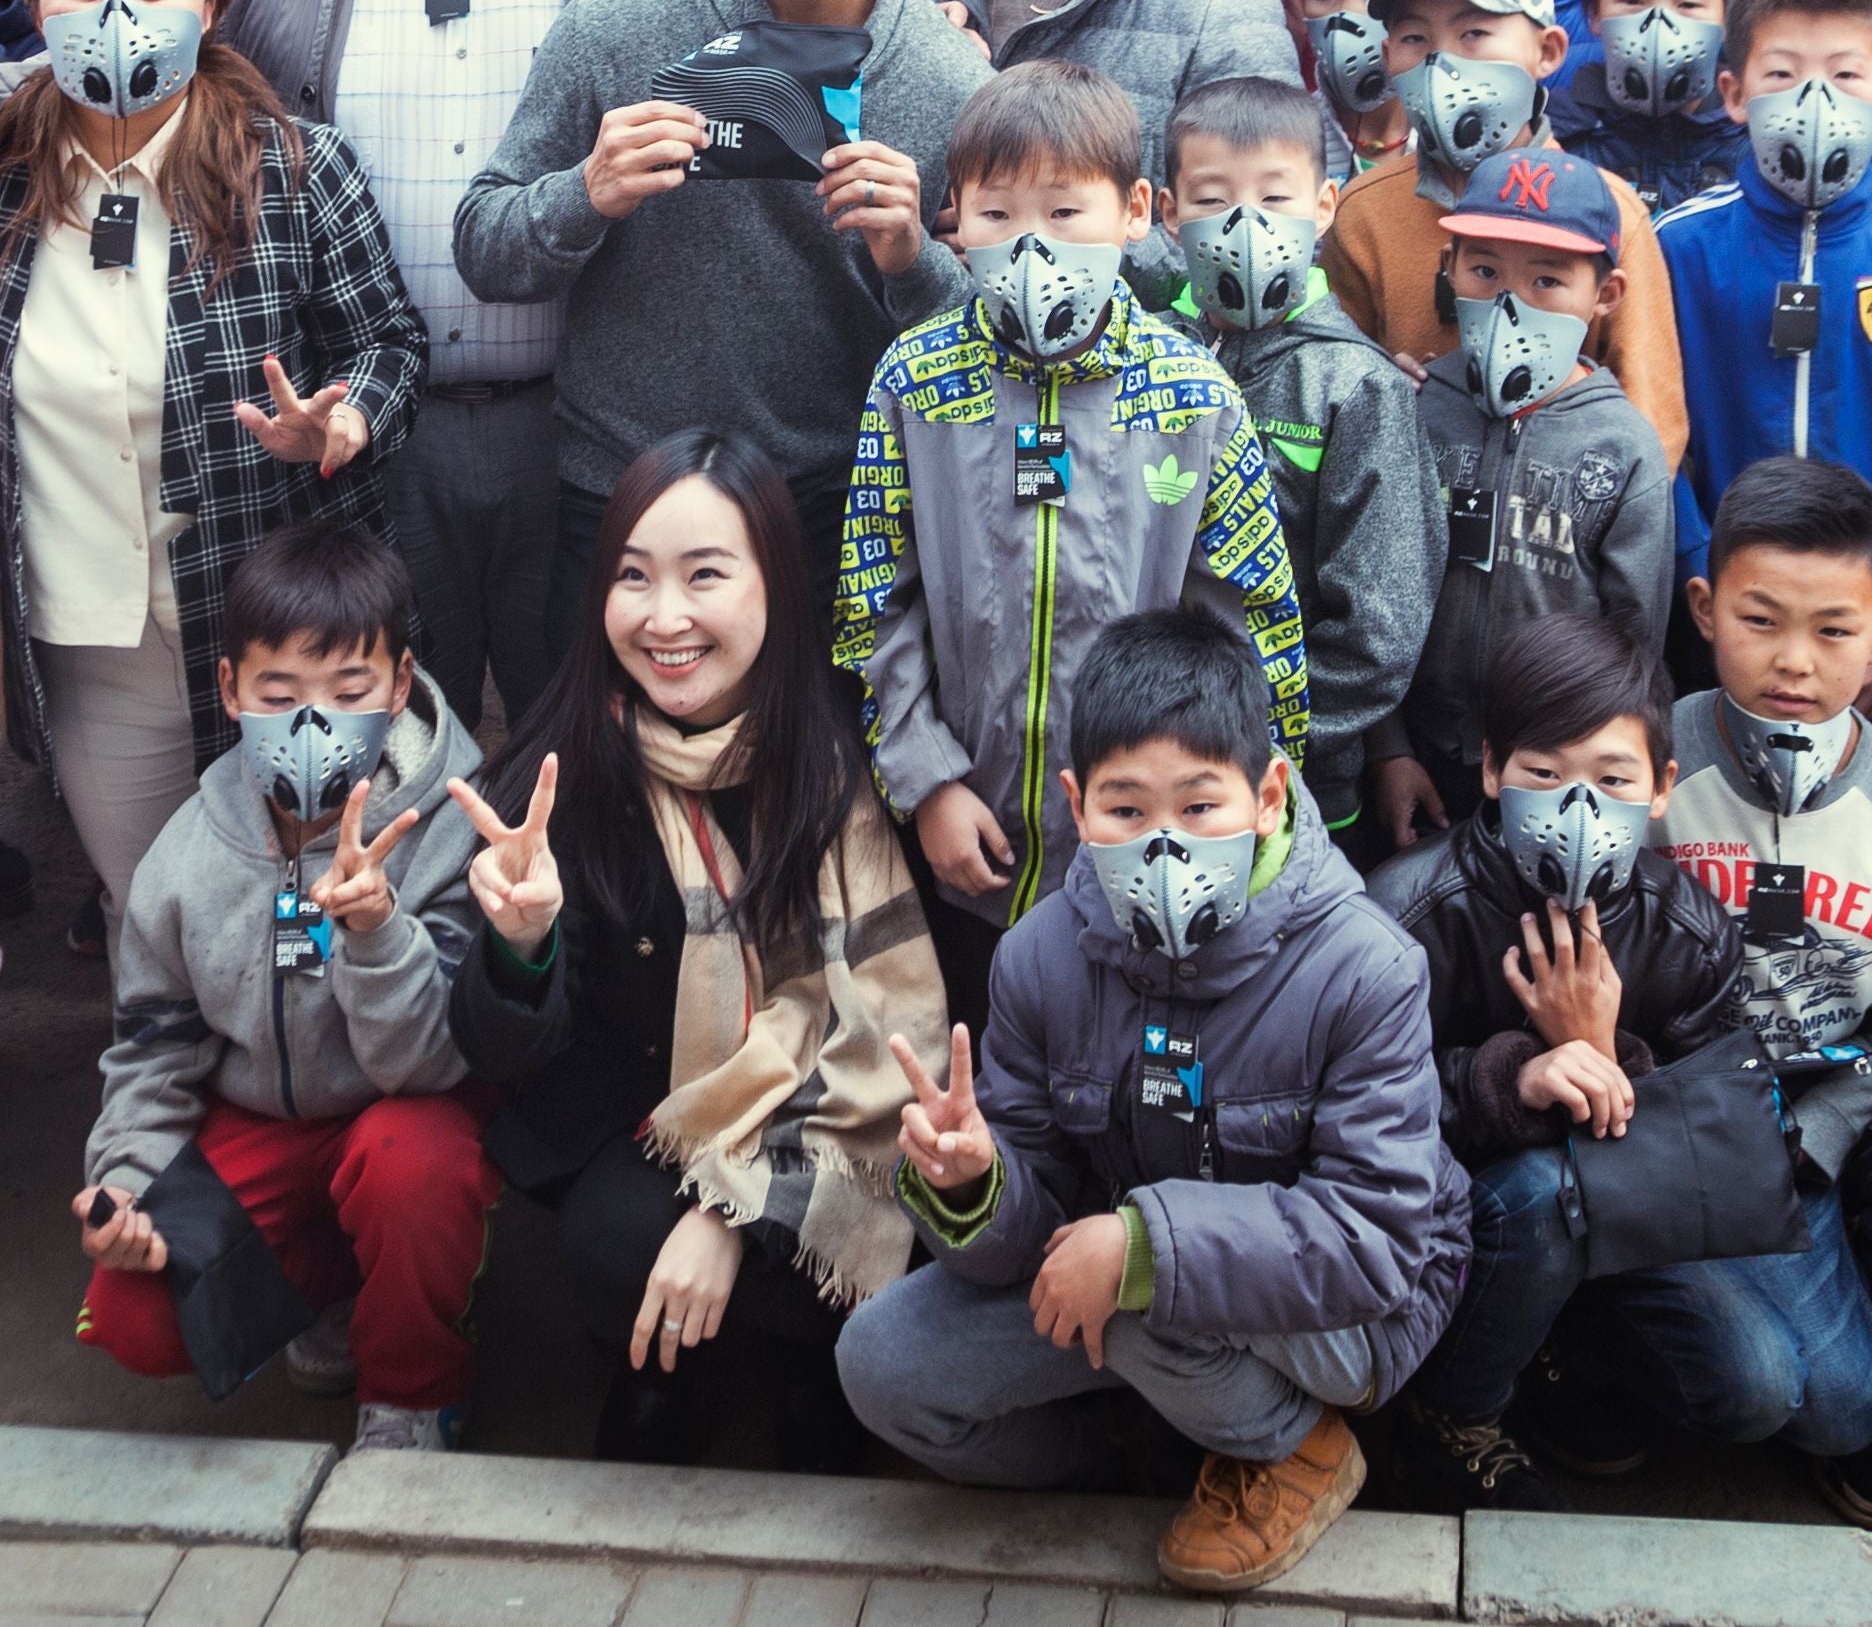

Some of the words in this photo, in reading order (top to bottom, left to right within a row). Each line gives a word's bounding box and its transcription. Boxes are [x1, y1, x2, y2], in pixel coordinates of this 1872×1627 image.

[1039, 432, 1063, 443] RZ
[1017, 472, 1056, 485] BREATHE
[1017, 483, 1039, 496] SAFE
[1708, 842, 1750, 857] BANK
[1168, 1040, 1193, 1055] RZ
[1142, 1078, 1183, 1098] BREATHE
[1142, 1092, 1164, 1107] SAFE
